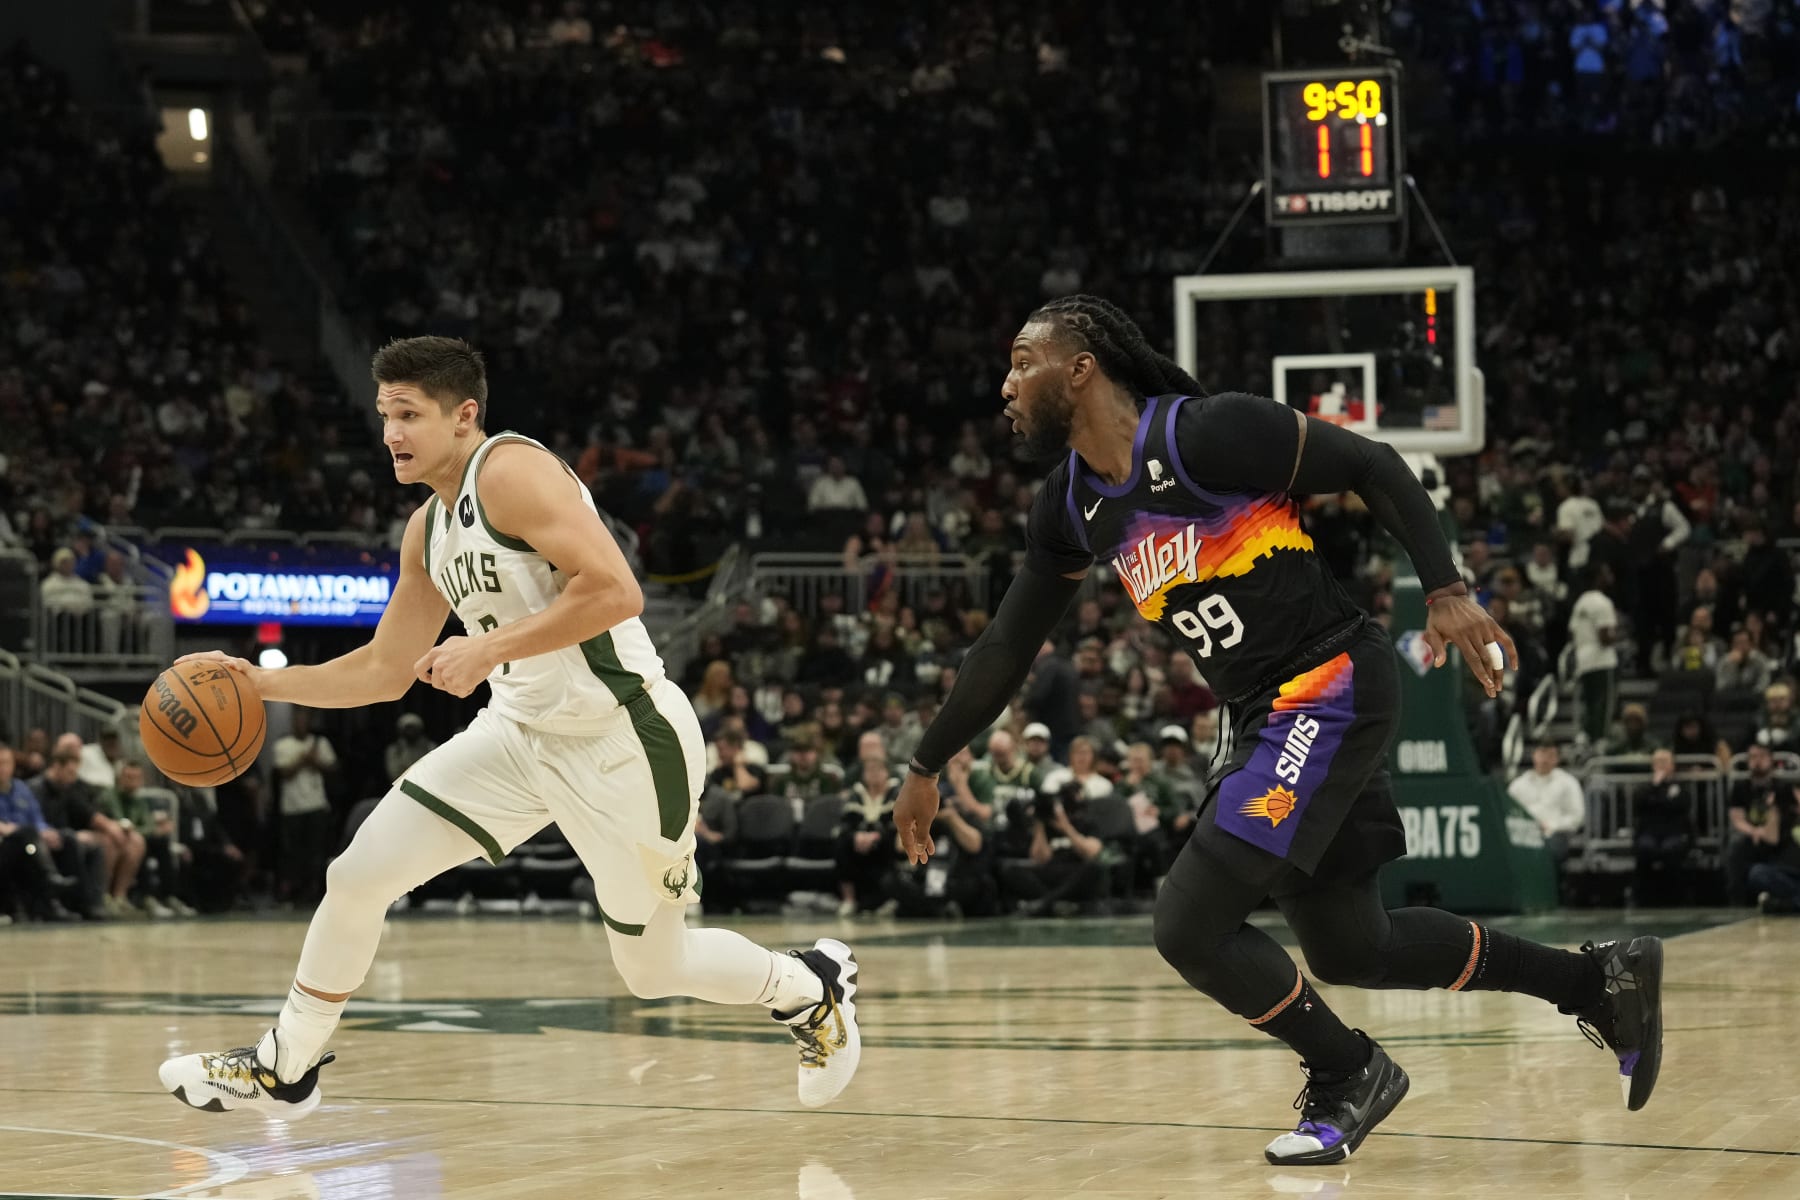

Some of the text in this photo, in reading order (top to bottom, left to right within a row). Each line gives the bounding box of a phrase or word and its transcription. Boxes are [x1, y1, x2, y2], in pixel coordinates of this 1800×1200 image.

[1303, 80, 1381, 121] 9:50
[1307, 189, 1393, 213] TISSOT
[1151, 478, 1176, 493] PayPal
[439, 551, 502, 609] UCKS
[1112, 523, 1202, 604] Valley
[1126, 551, 1139, 567] THE
[207, 572, 390, 603] POTAWATOMI
[1172, 594, 1244, 658] 99
[1275, 713, 1320, 785] SUNS
[1397, 806, 1480, 858] BA75
